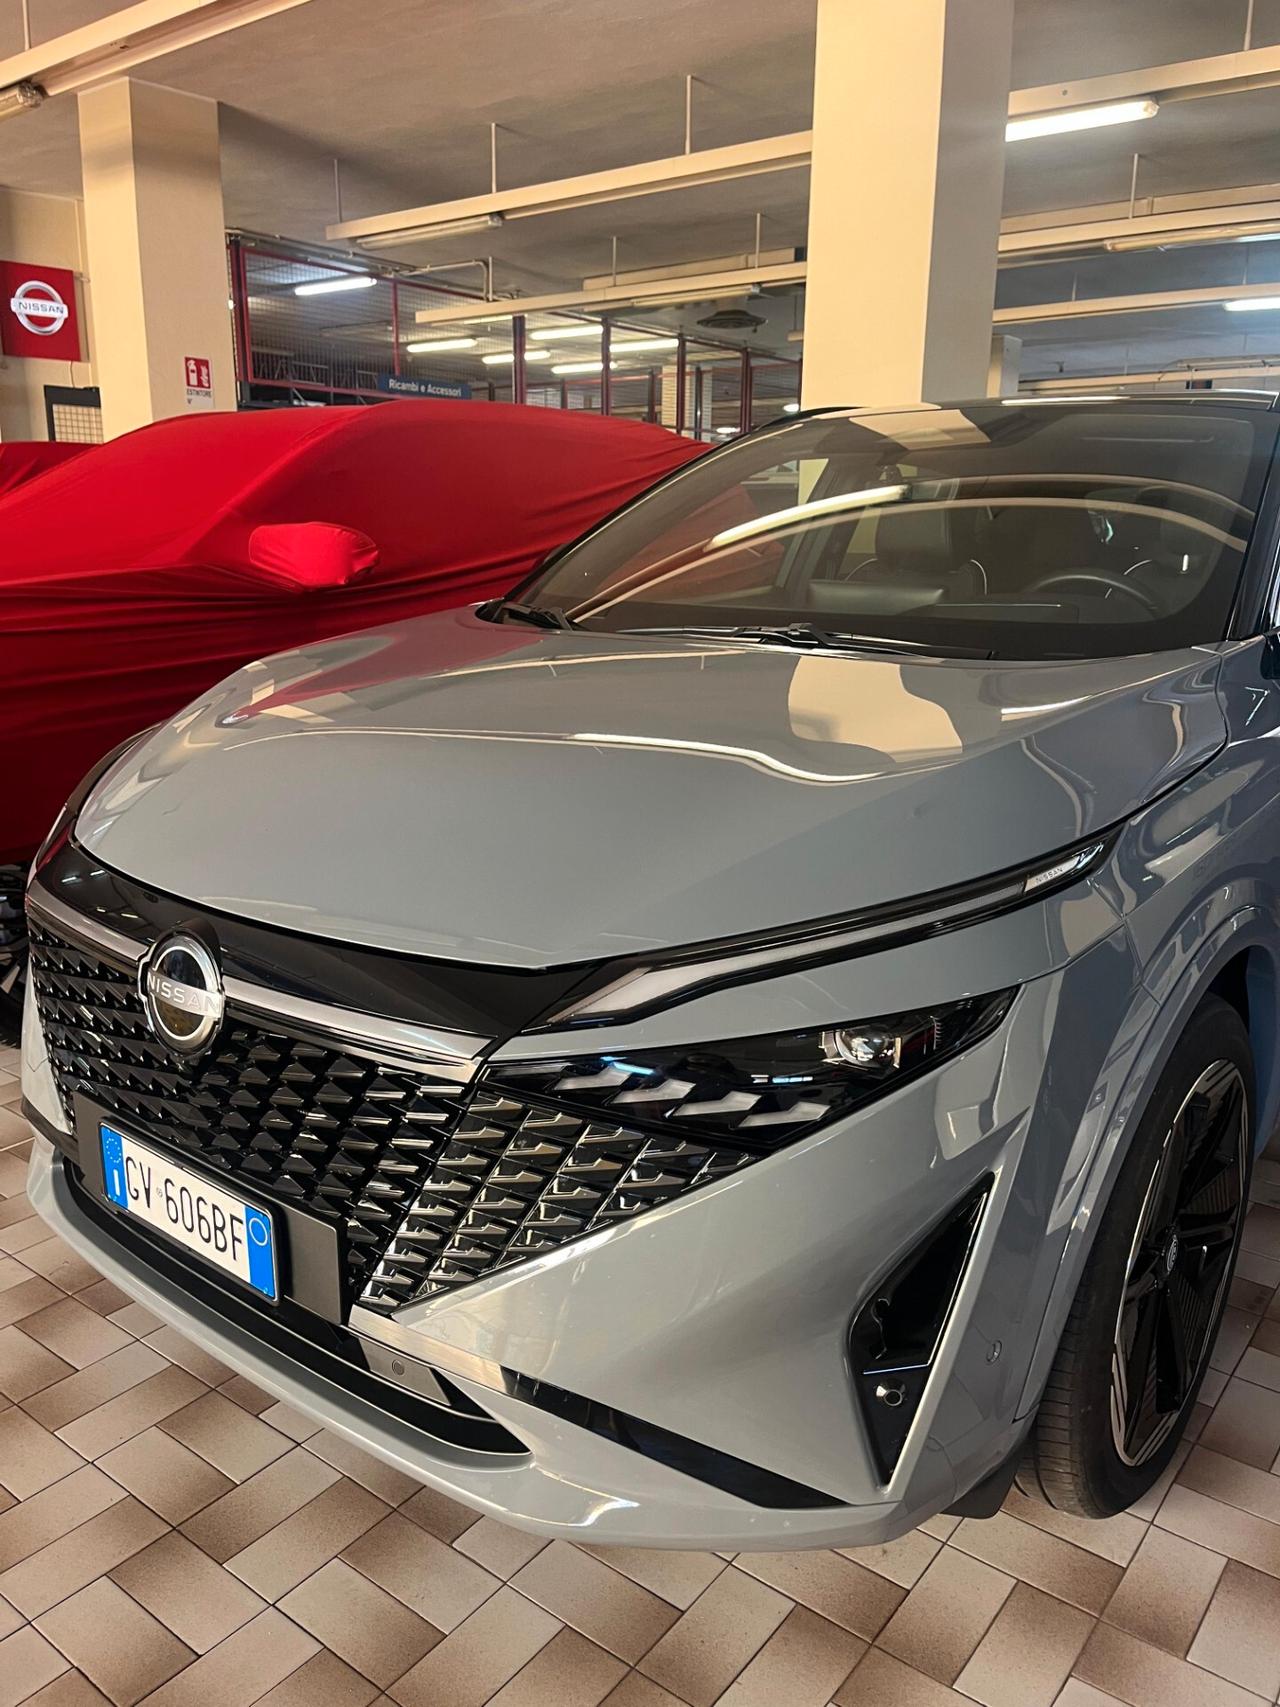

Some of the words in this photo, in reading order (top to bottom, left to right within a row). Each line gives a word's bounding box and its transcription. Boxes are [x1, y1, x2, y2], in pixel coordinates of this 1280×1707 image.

[18, 301, 65, 315] NISSAN
[388, 378, 419, 391] Ricambi
[427, 384, 461, 396] Accessori
[1035, 867, 1064, 883] NISSAN
[147, 971, 221, 1014] NISSAN
